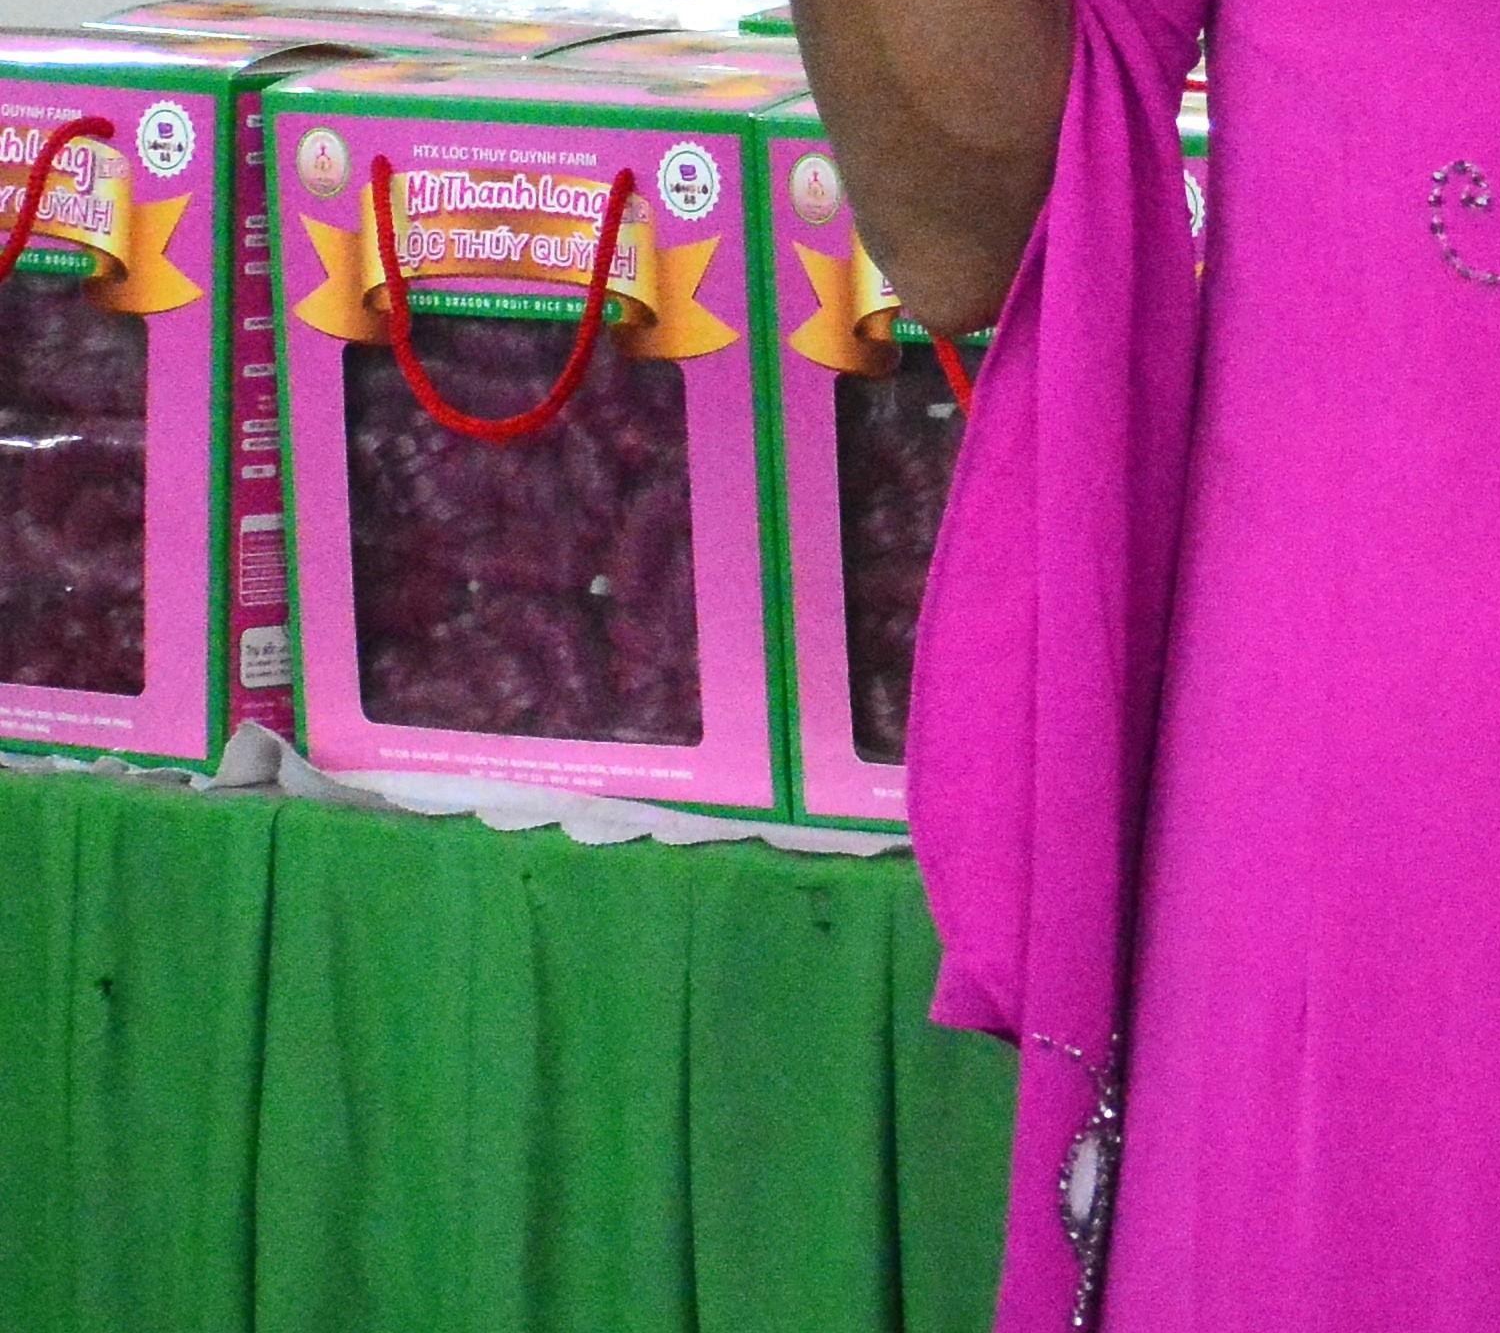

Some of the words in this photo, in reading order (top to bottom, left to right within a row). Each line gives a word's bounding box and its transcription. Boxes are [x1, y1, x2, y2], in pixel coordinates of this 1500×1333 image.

[406, 171, 439, 217] Mì
[440, 171, 536, 210] Thanh
[540, 173, 609, 234] Long
[449, 221, 529, 261] THÚY
[532, 227, 637, 280] QUỲH
[445, 295, 492, 310] DRAGON
[495, 297, 529, 311] FRUIT
[534, 299, 561, 313] RICE
